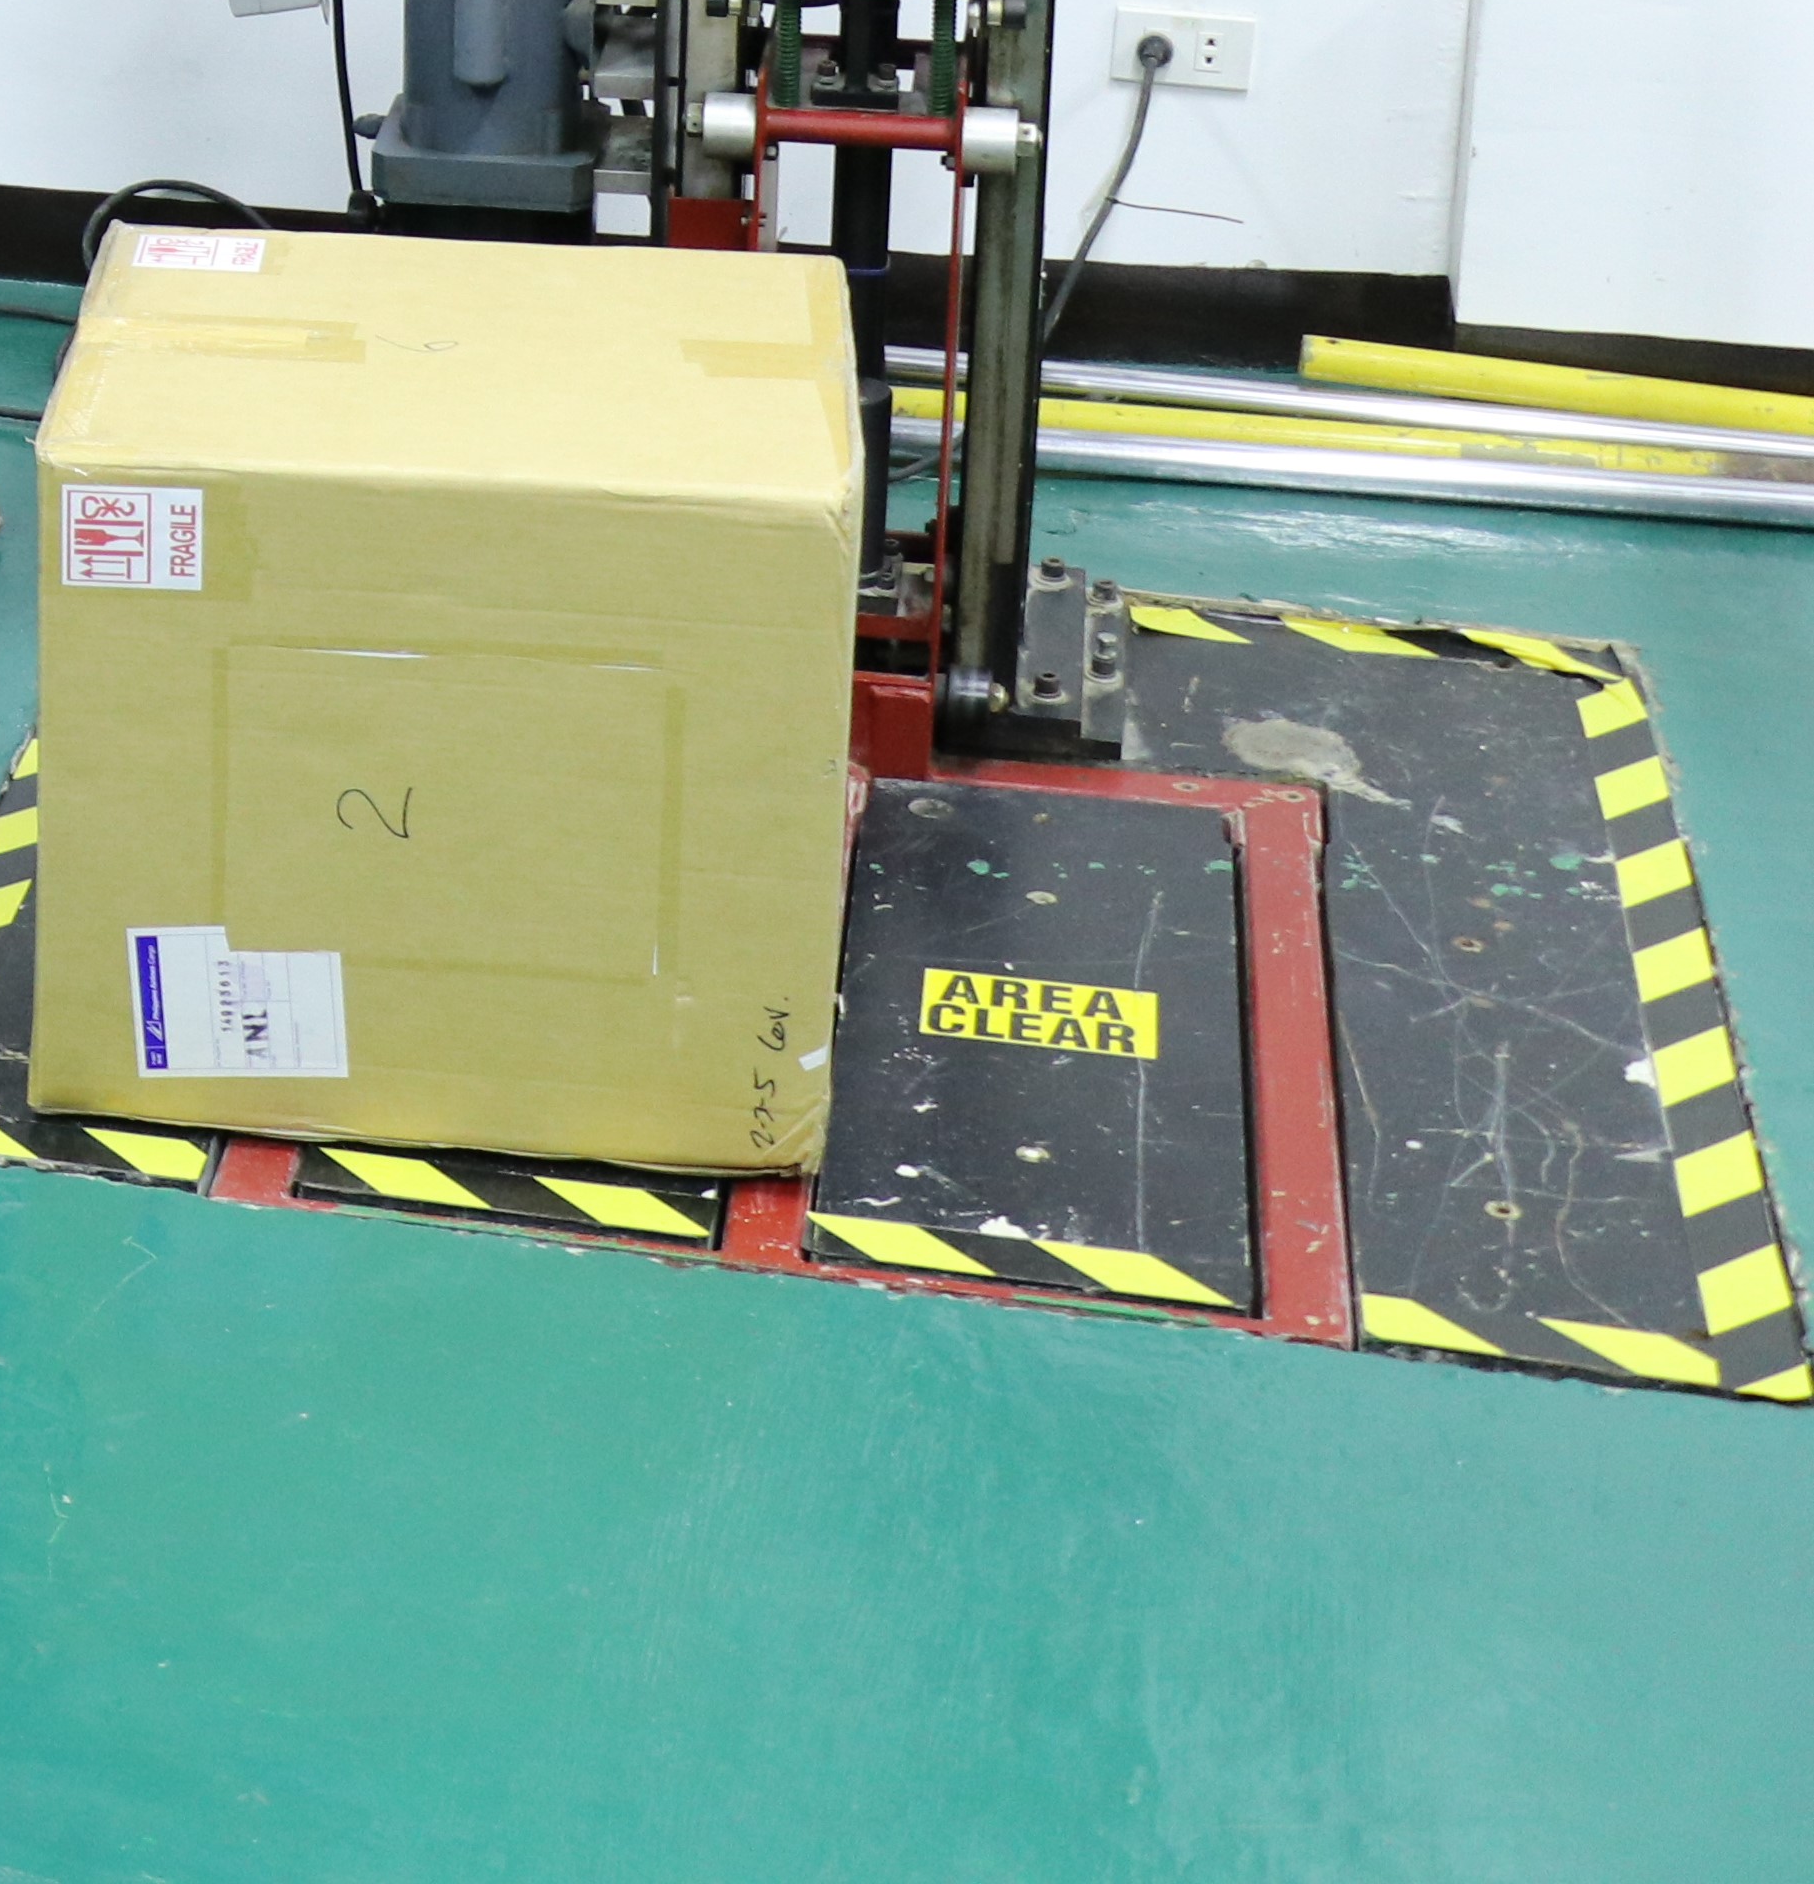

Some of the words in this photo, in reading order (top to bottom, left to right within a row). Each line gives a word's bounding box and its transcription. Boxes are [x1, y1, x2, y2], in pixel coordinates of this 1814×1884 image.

[232, 241, 259, 265] FRAGILE
[170, 504, 196, 577] FRAGILE
[336, 787, 413, 838] 2
[940, 975, 1123, 1021] AREA
[927, 1003, 1135, 1054] CLEAR
